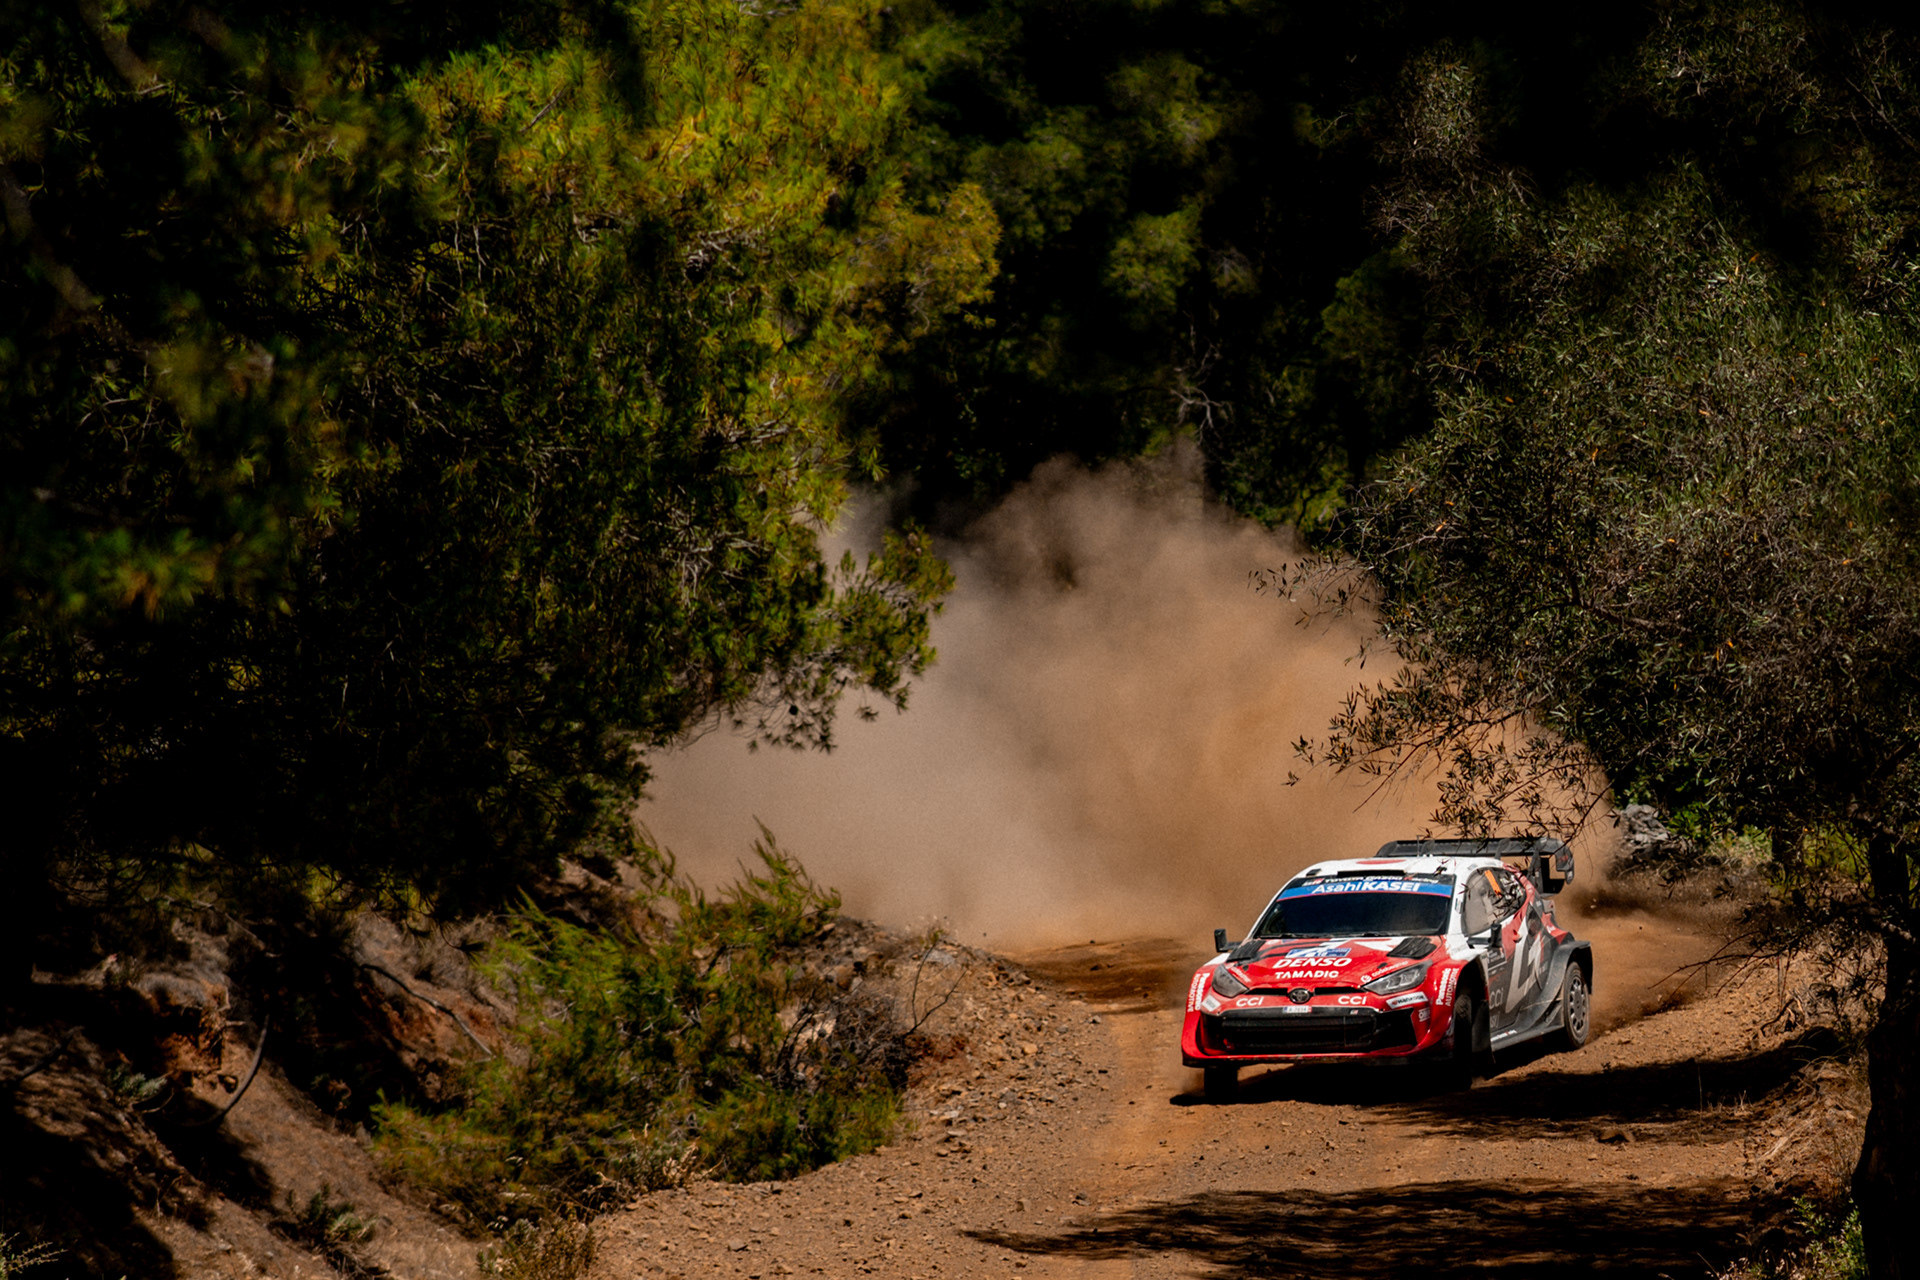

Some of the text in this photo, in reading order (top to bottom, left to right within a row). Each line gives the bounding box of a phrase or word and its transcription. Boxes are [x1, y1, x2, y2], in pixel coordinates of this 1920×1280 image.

[1272, 957, 1352, 969] DENSO
[1275, 970, 1339, 979] TAMADIC
[1194, 972, 1210, 1011] Panasonic
[1435, 968, 1451, 1005] Panasonic
[1236, 996, 1265, 1007] CCI
[1337, 995, 1367, 1005] CCI
